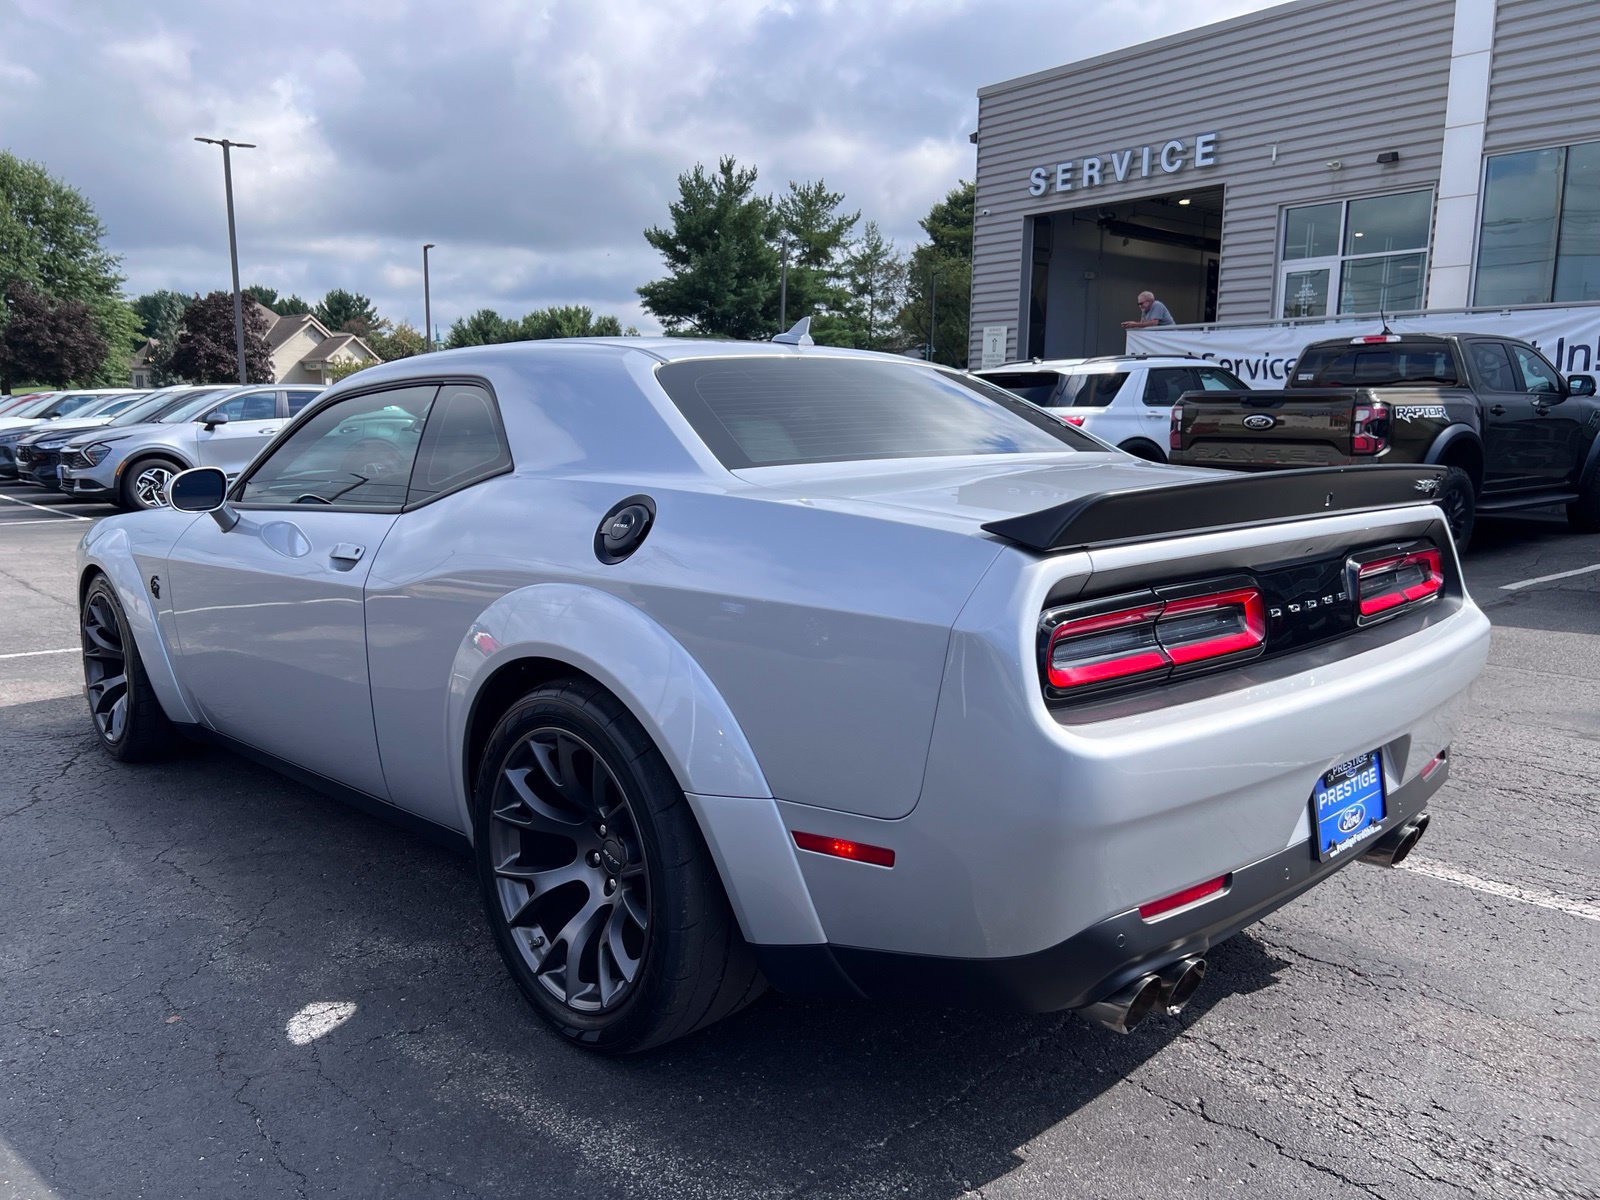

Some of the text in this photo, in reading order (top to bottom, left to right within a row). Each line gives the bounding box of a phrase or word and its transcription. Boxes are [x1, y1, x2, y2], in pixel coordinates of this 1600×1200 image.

[1028, 131, 1217, 197] SERVICE
[1395, 405, 1451, 423] RAPTOR
[1269, 591, 1347, 618] DODGE
[1332, 753, 1368, 775] PRESTIGE
[1318, 767, 1377, 810] PRESTIGE
[1341, 807, 1362, 831] Ford
